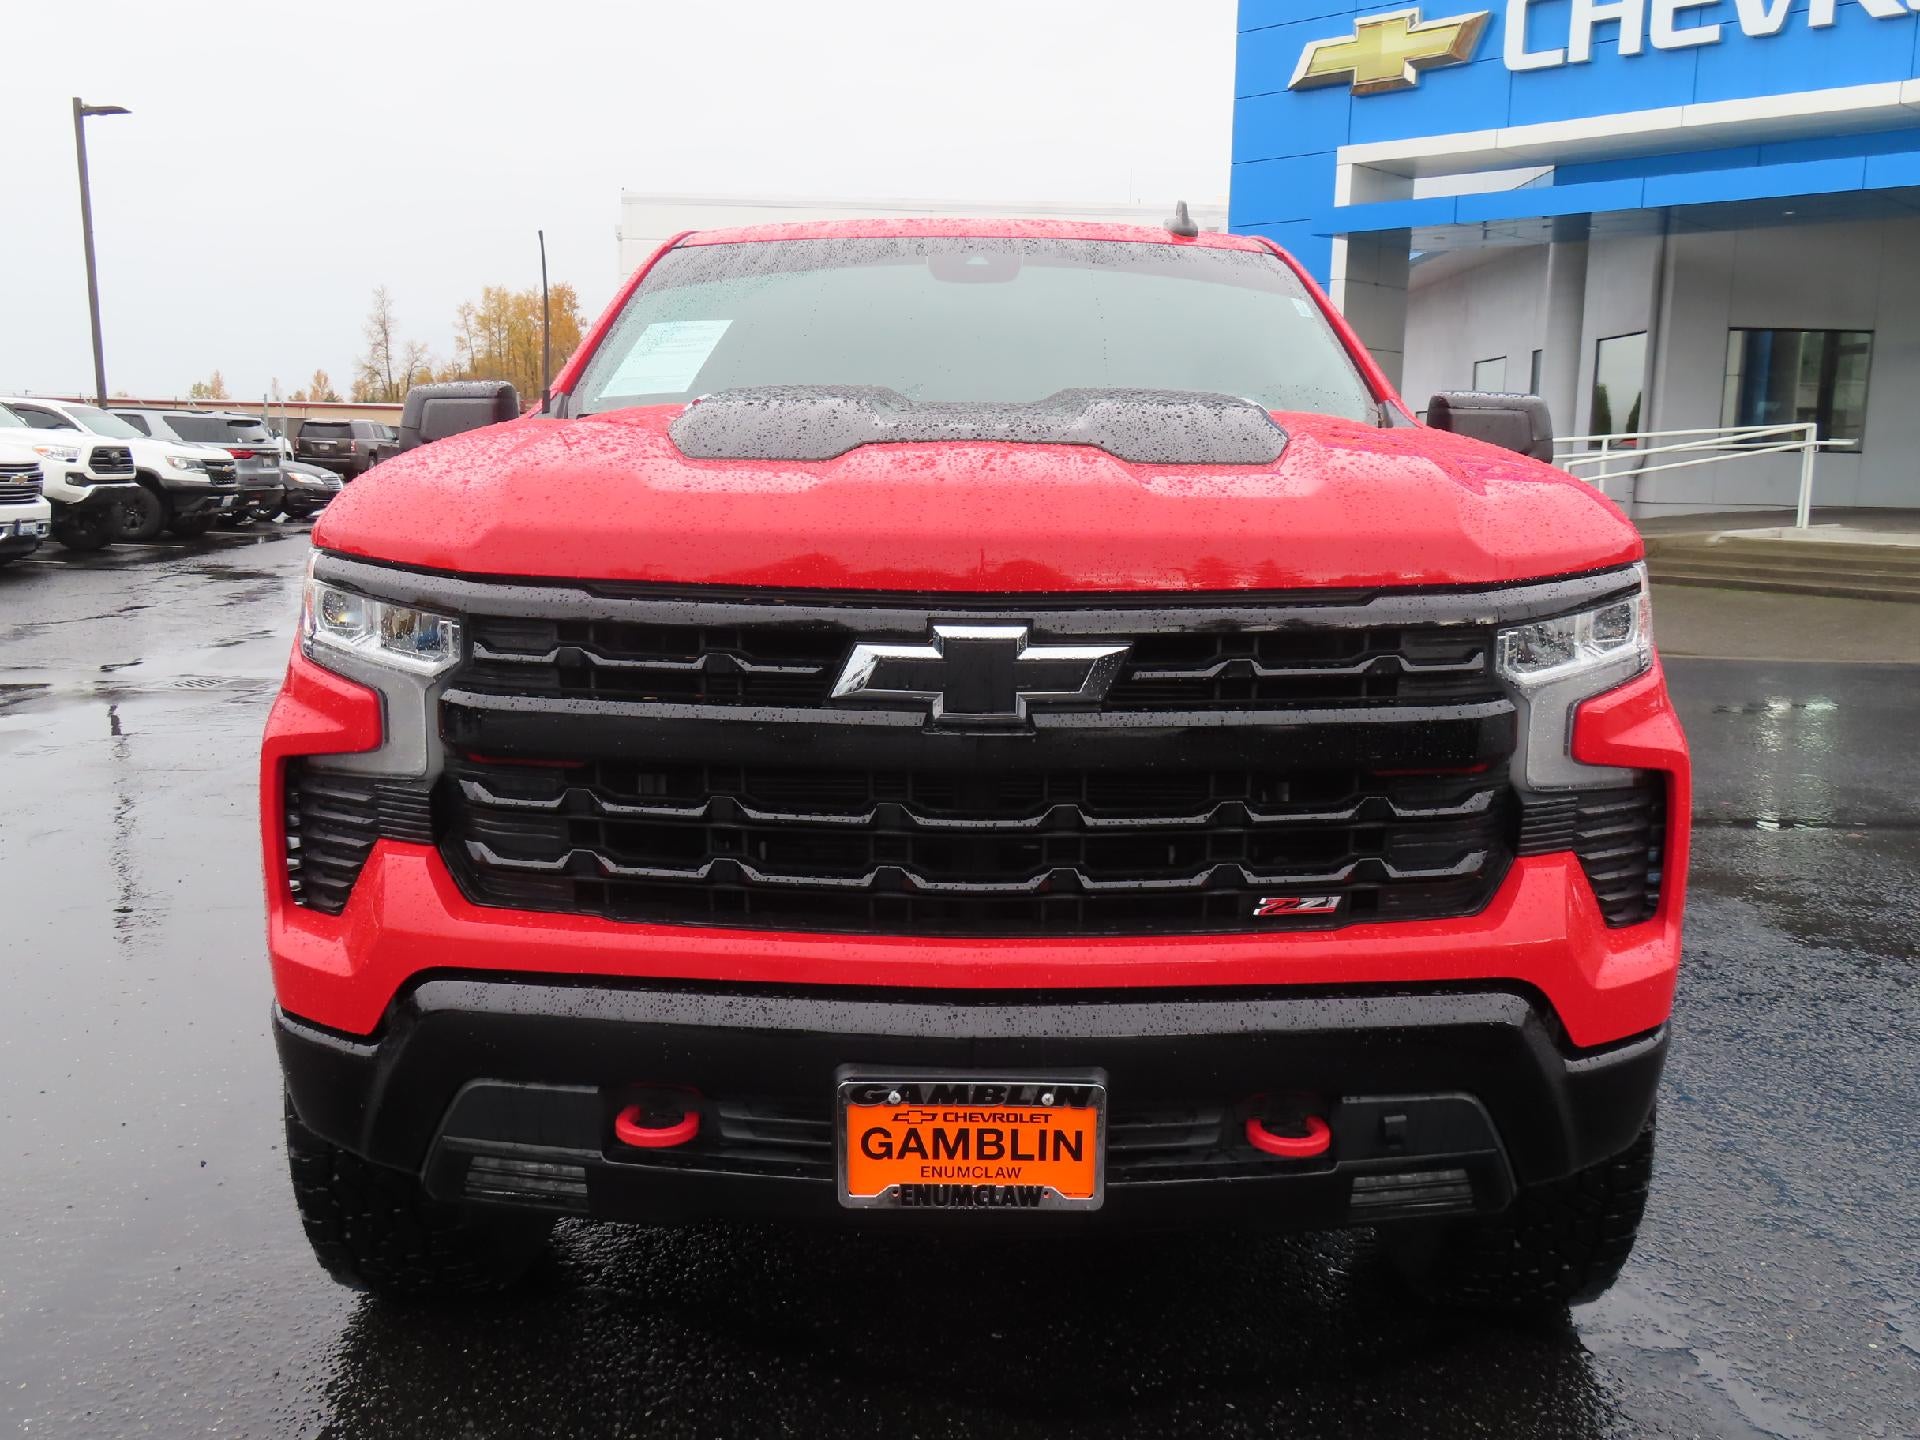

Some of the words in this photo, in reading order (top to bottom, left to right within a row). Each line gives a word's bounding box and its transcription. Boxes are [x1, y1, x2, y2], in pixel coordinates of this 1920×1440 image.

[1253, 896, 1341, 915] Z71
[943, 1111, 1052, 1124] CHEVROLET
[860, 1127, 1083, 1162] GAMBLIN
[920, 1166, 1022, 1179] ENUMCLAW
[900, 1184, 1044, 1207] ENUMCLAW
